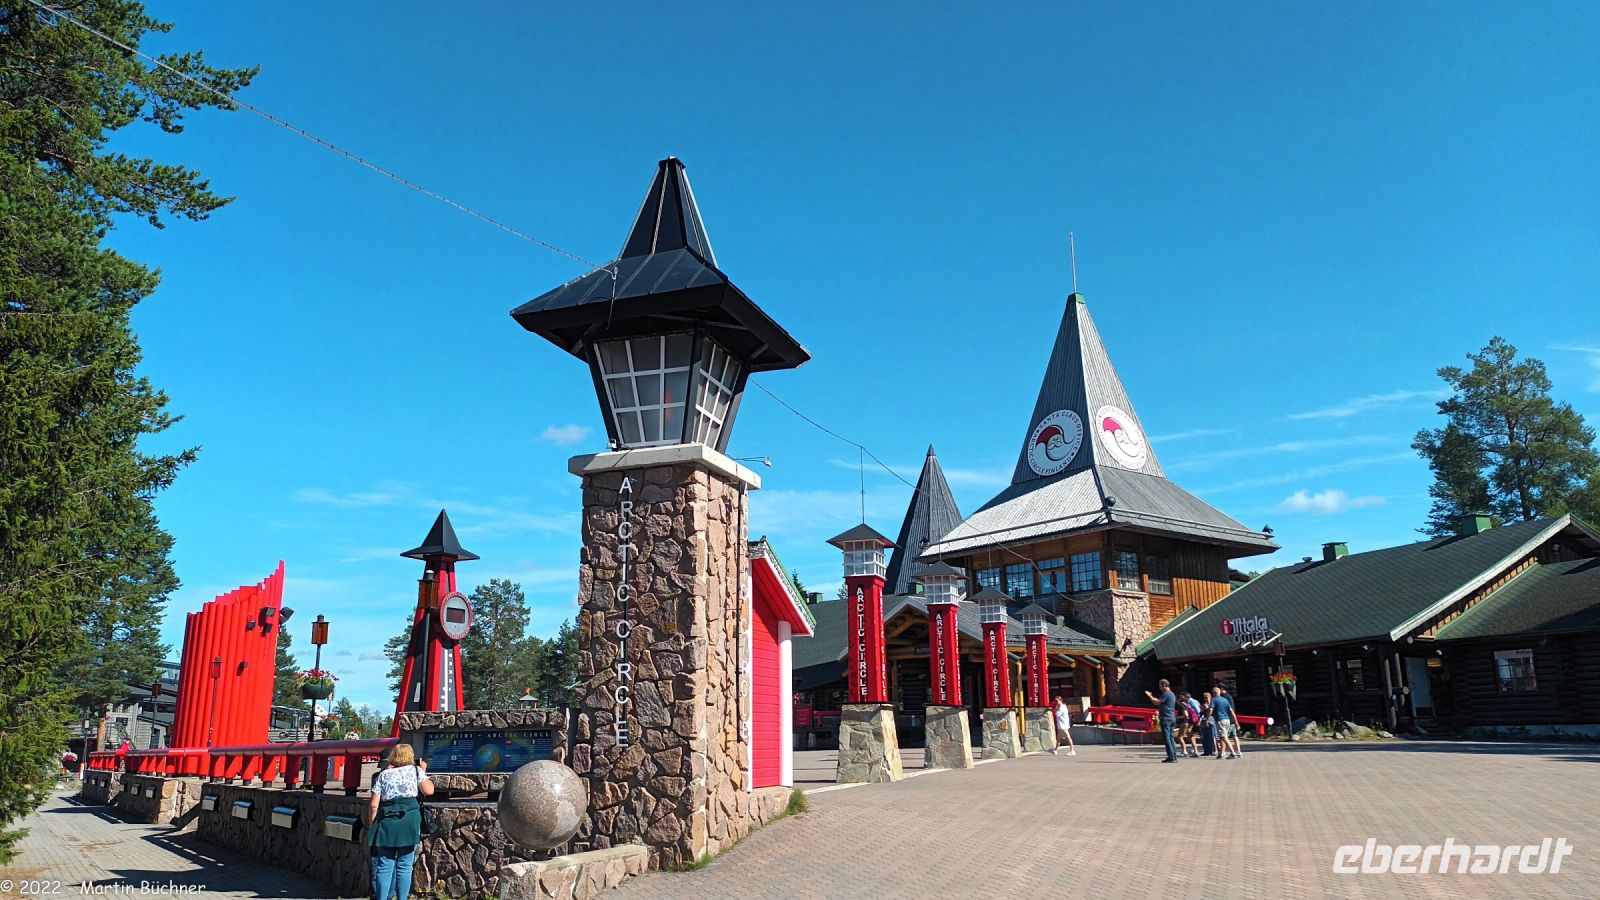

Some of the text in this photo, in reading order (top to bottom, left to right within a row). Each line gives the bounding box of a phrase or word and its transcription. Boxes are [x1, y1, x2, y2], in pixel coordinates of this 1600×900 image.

[1029, 434, 1073, 474] ARCTIC CIRCLE FINLAND
[1040, 411, 1082, 450] SANTA CLAUS OFFICE
[614, 476, 633, 748] ARCTIC CIRCLE
[856, 587, 868, 696] ARCTIC CIRCLE
[1233, 630, 1267, 645] OUTLET
[936, 613, 947, 701] ARCTIC CIRCLE
[989, 629, 1000, 703] ARCTIC CIRCLE
